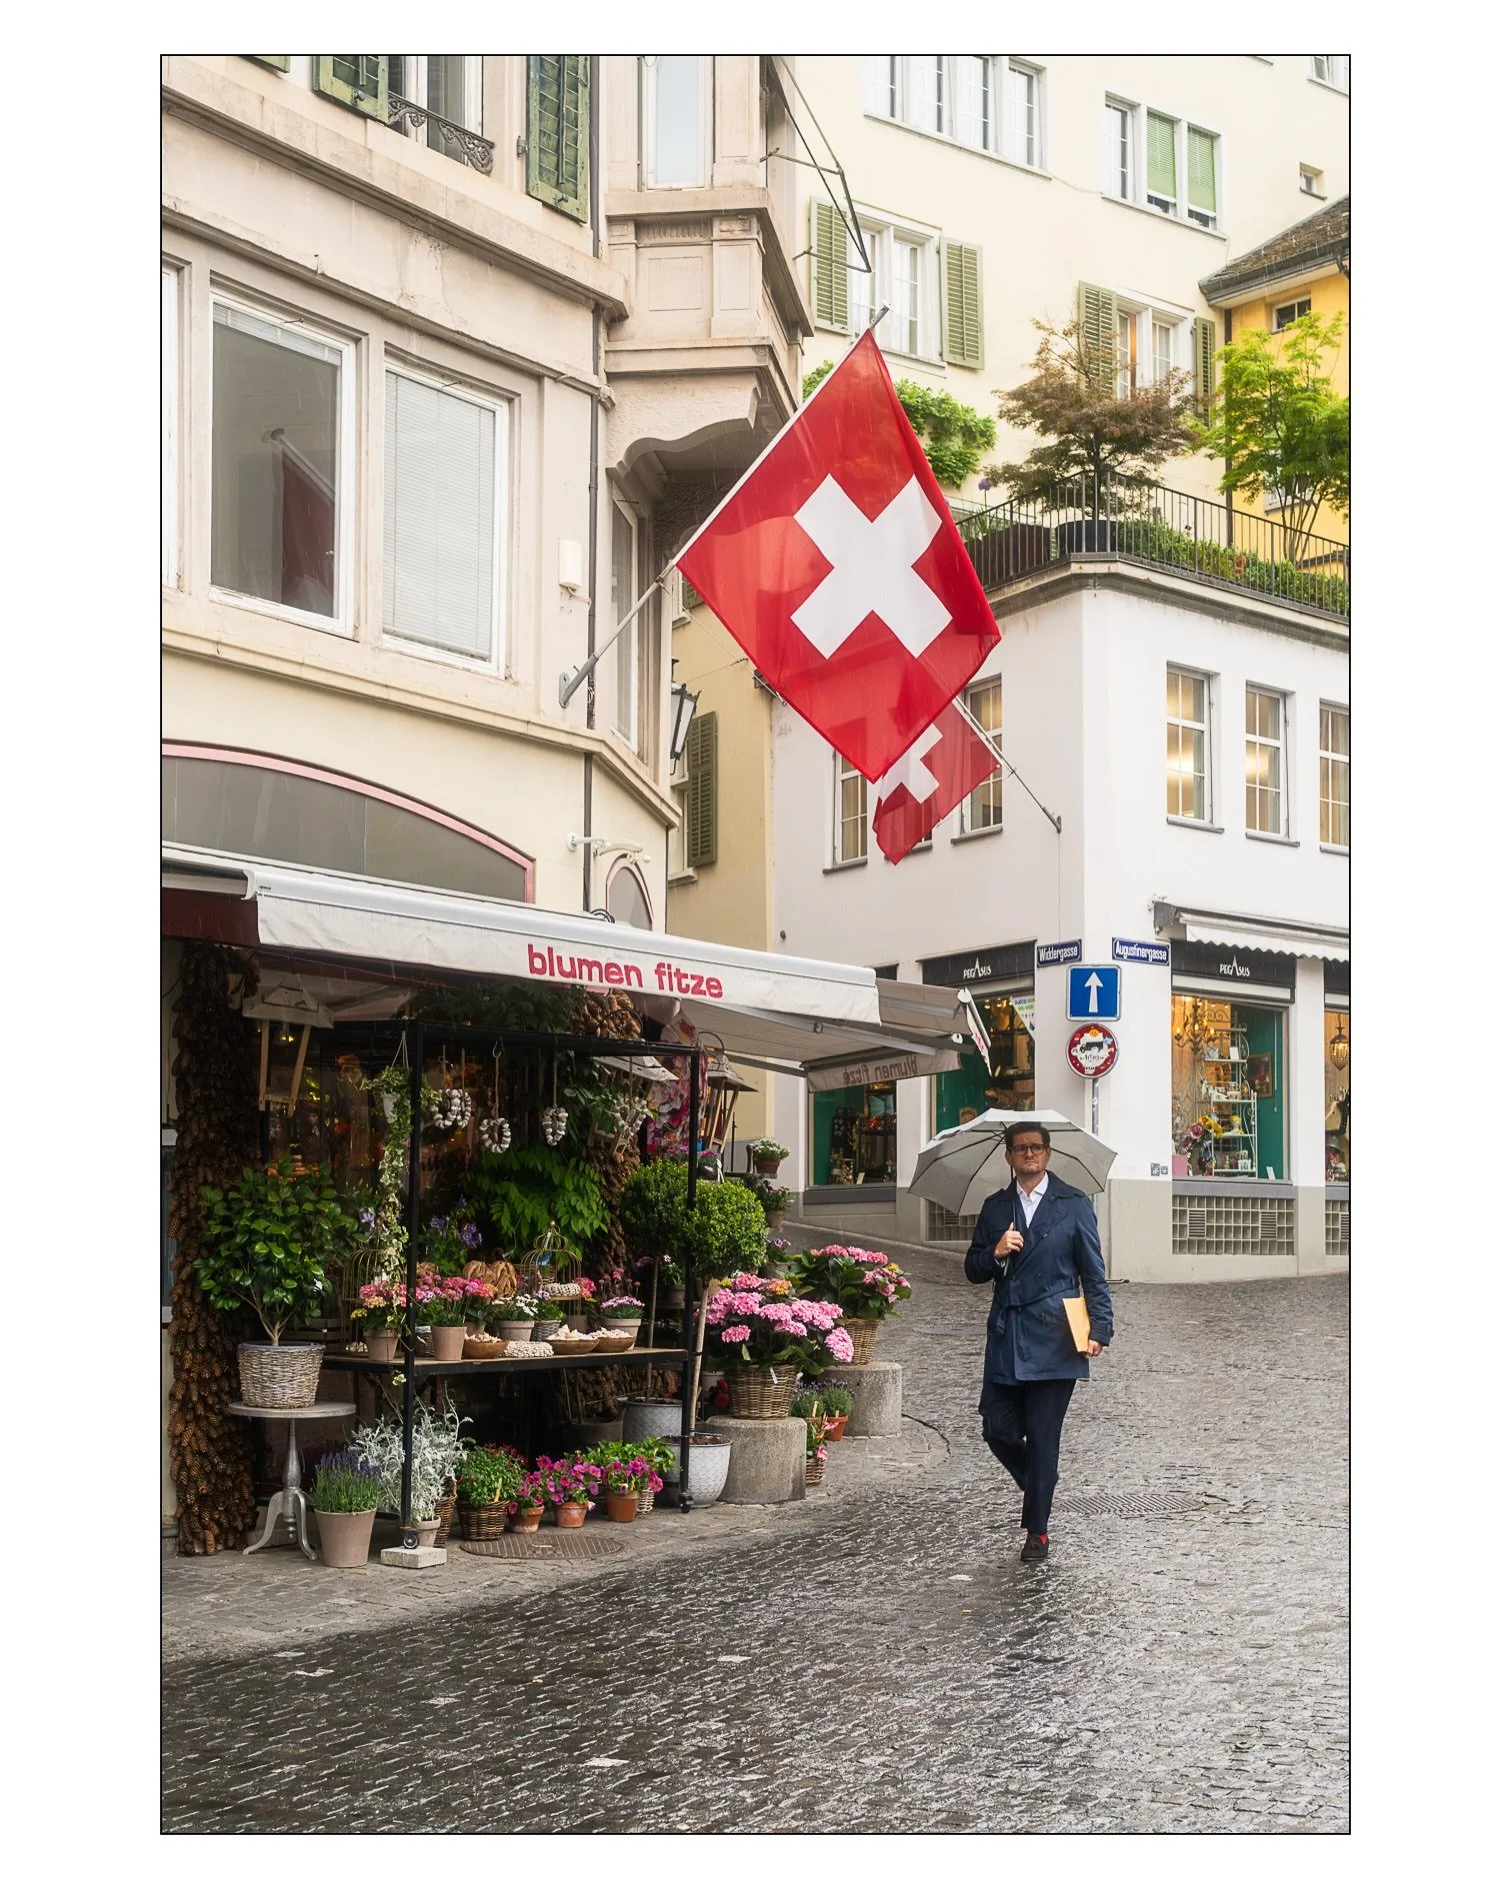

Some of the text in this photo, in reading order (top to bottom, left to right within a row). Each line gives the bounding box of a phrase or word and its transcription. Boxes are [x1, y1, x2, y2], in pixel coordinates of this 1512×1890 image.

[1039, 946, 1078, 962] Widdergasse
[1115, 941, 1167, 961] Augustinergasse
[527, 944, 724, 998] blumen fitze
[963, 957, 992, 979] PEGASUS
[1219, 955, 1250, 976] PEGASUS
